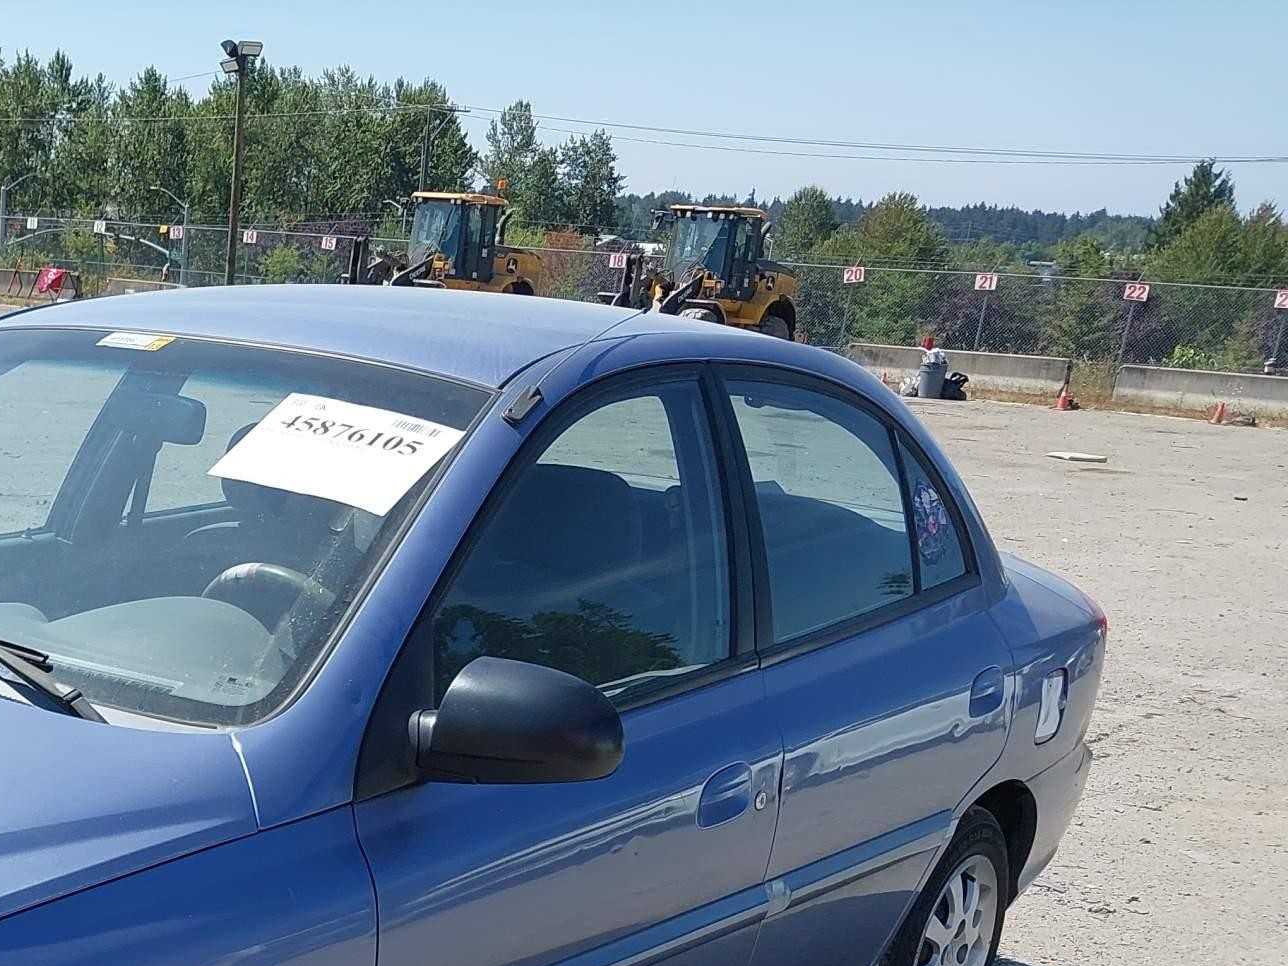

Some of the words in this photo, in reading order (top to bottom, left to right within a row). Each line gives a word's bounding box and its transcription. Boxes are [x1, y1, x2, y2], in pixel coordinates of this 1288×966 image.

[172, 227, 181, 238] 13
[245, 231, 255, 242] 14
[324, 238, 334, 249] 15
[613, 255, 624, 267] 18
[845, 269, 862, 282] 20
[978, 276, 993, 289] 21
[1126, 285, 1147, 300] 22
[281, 414, 425, 456] 45876105
